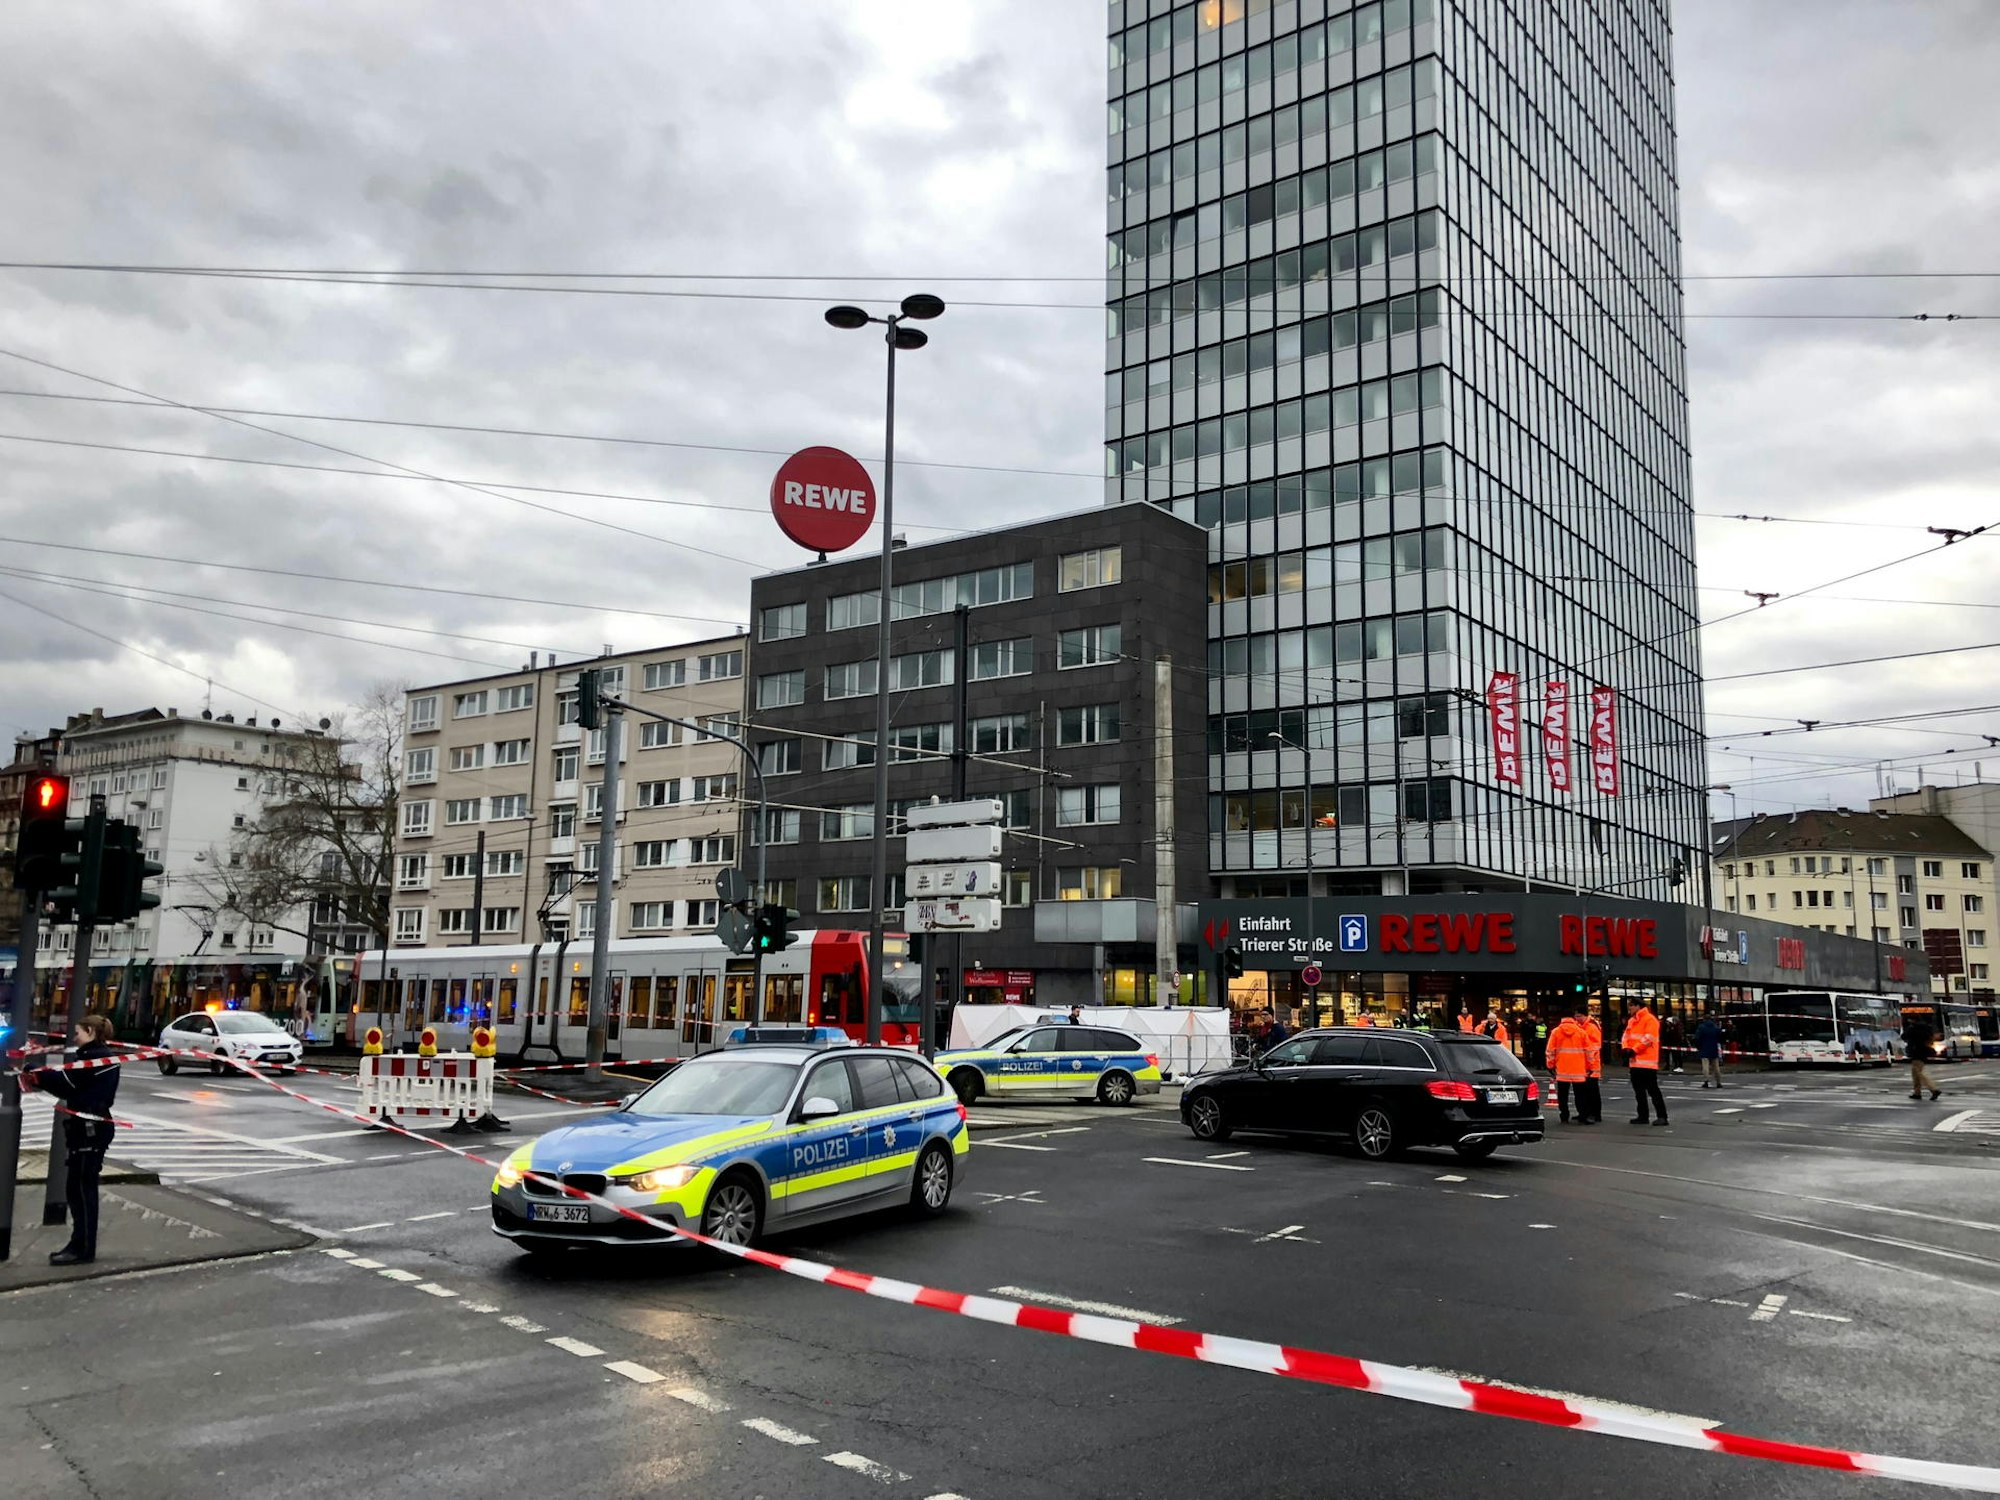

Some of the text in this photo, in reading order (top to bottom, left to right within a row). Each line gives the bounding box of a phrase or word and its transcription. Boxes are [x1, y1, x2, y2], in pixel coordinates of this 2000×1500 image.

[784, 480, 867, 515] REWE
[1239, 917, 1291, 931] Einfahrt
[1379, 913, 1517, 953] REWE
[1559, 914, 1659, 957] REWE
[1240, 938, 1285, 951] Trierer
[1002, 1061, 1043, 1071] POLIZEI
[793, 1137, 849, 1168] POLIZEI
